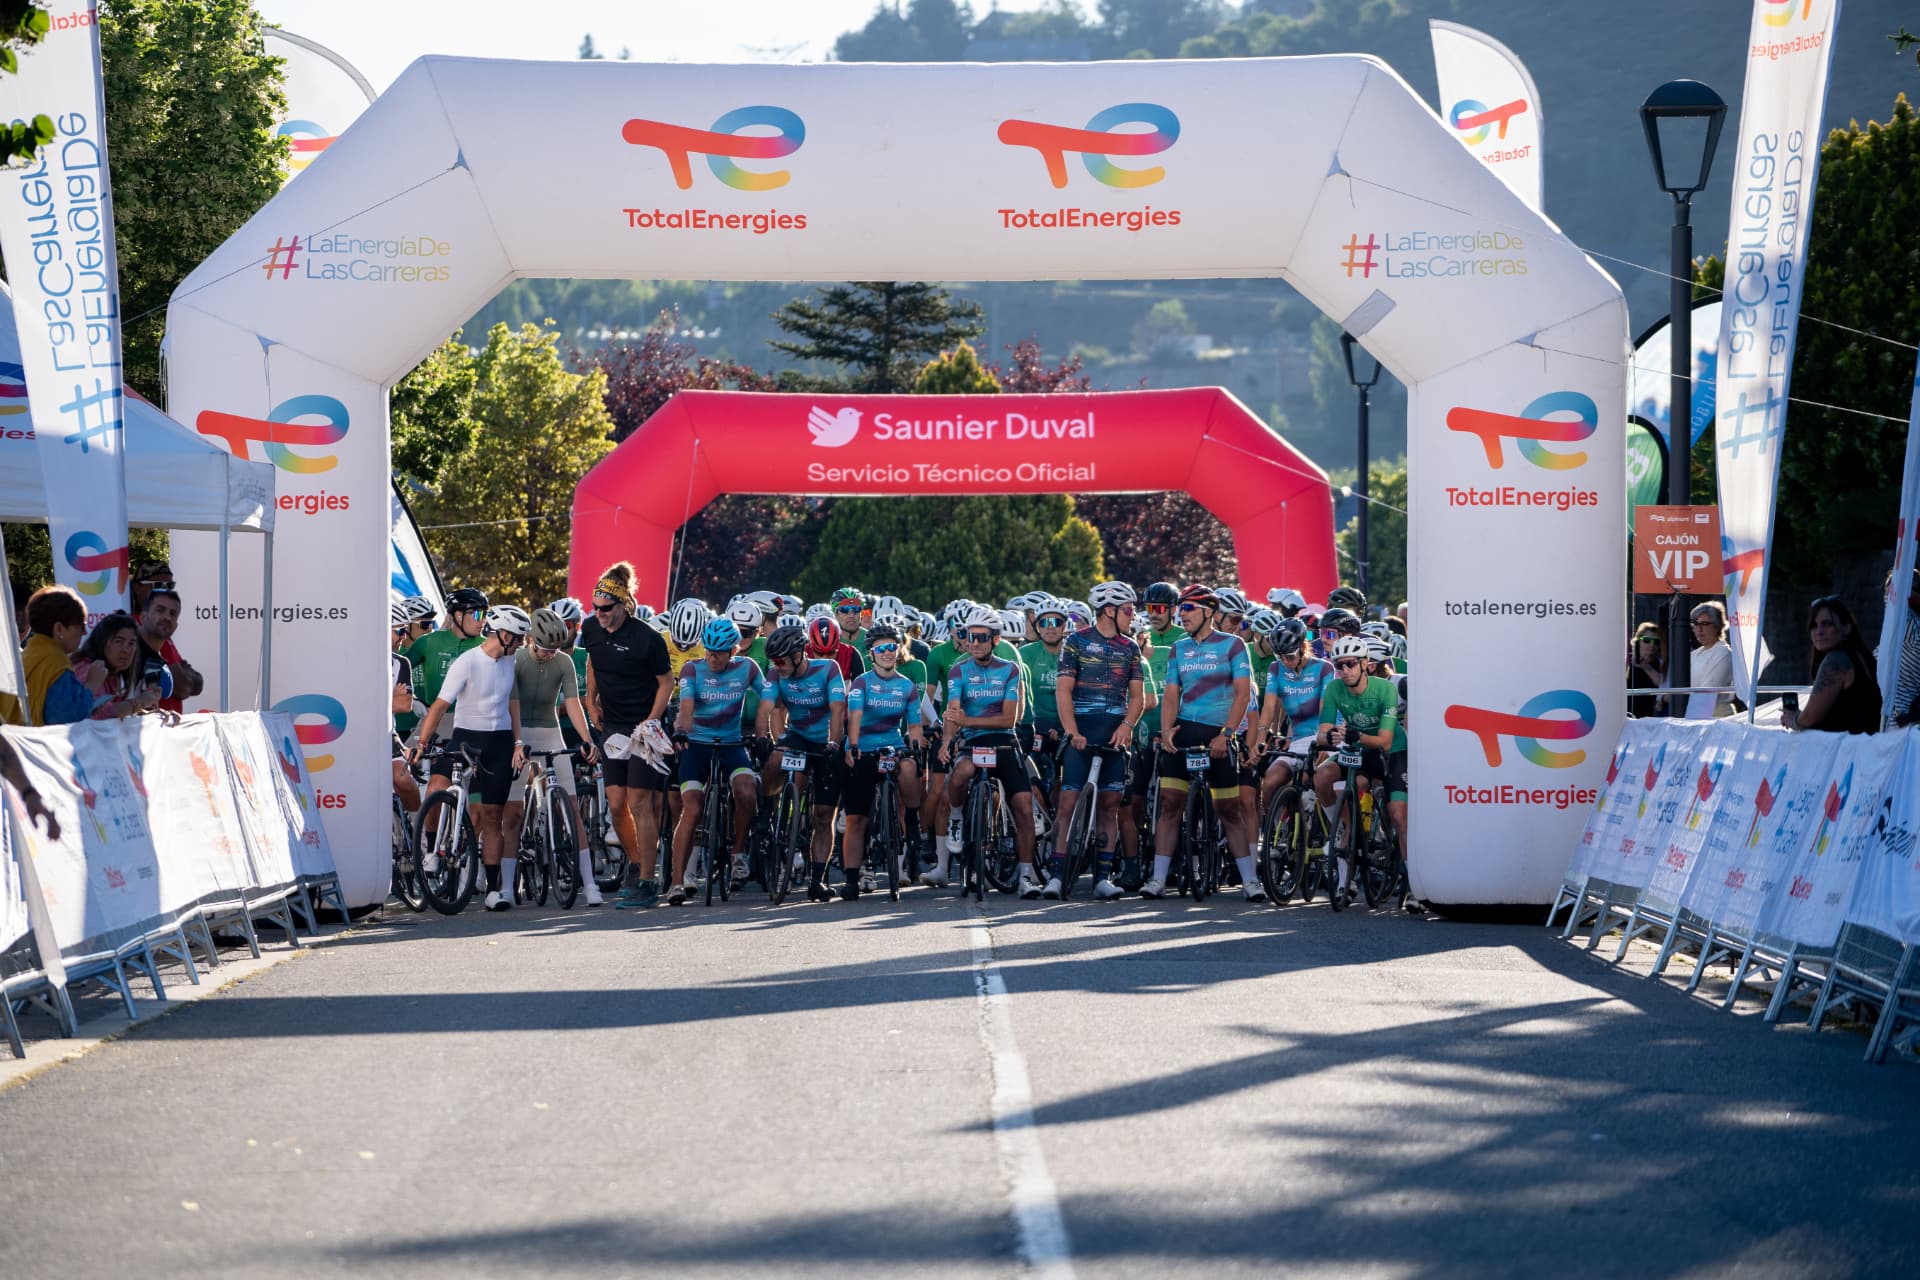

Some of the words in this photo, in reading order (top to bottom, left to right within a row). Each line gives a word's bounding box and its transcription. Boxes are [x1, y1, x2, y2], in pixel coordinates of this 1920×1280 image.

[623, 208, 807, 234] TotalEnergies
[998, 206, 1181, 231] TotalEnergies
[306, 257, 450, 282] LasCarreras
[1386, 255, 1529, 278] LasCarreras
[873, 413, 998, 440] Saunier
[1006, 412, 1095, 439] Duval
[808, 463, 910, 483] Servicio
[913, 463, 1012, 483] Técnico
[1016, 462, 1096, 481] Oficial
[1446, 486, 1598, 511] TotalEnergies
[1655, 532, 1699, 545] CAJÓN
[1648, 550, 1710, 579] VIP
[195, 603, 348, 623] totlenrgies.es
[1445, 600, 1597, 619] totalenergies.es
[1180, 662, 1217, 672] alpinum
[701, 691, 741, 701] alpinum
[868, 697, 902, 708] alpinum
[967, 688, 1003, 698] alpinum
[785, 758, 802, 767] 741
[1341, 756, 1360, 765] 806
[1444, 784, 1597, 810] TotalEnergies
